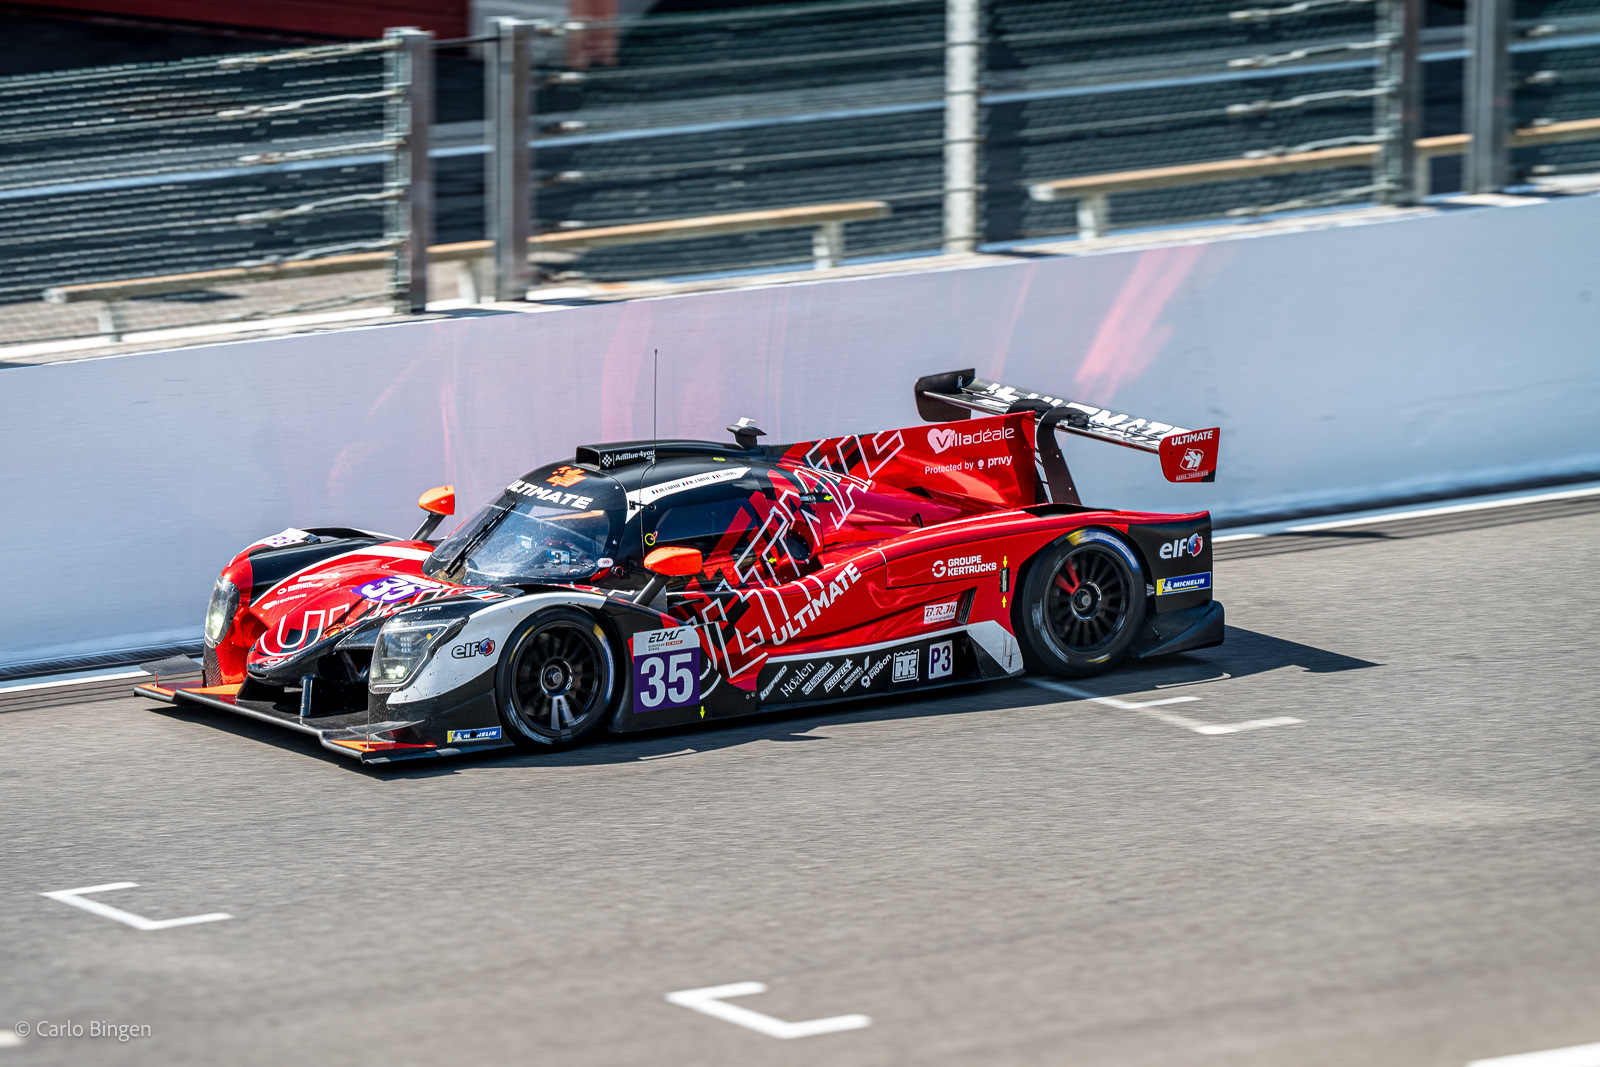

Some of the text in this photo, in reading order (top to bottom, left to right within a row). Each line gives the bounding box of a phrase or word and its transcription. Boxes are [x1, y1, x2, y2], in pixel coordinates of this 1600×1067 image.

[1171, 430, 1213, 446] ULTIMATE
[925, 456, 1012, 474] Protected by privy
[506, 479, 594, 510] ULTIMATE
[1160, 538, 1187, 559] elf
[948, 555, 982, 567] GROUPE
[948, 562, 997, 576] KERTRUCKS
[1173, 578, 1205, 588] MICHELIN
[772, 563, 862, 646] ULTIMATE
[648, 629, 686, 644] ELMS
[452, 642, 479, 659] elf
[930, 645, 951, 674] P3
[640, 652, 694, 707] 35
[464, 730, 497, 738] MHELIN
